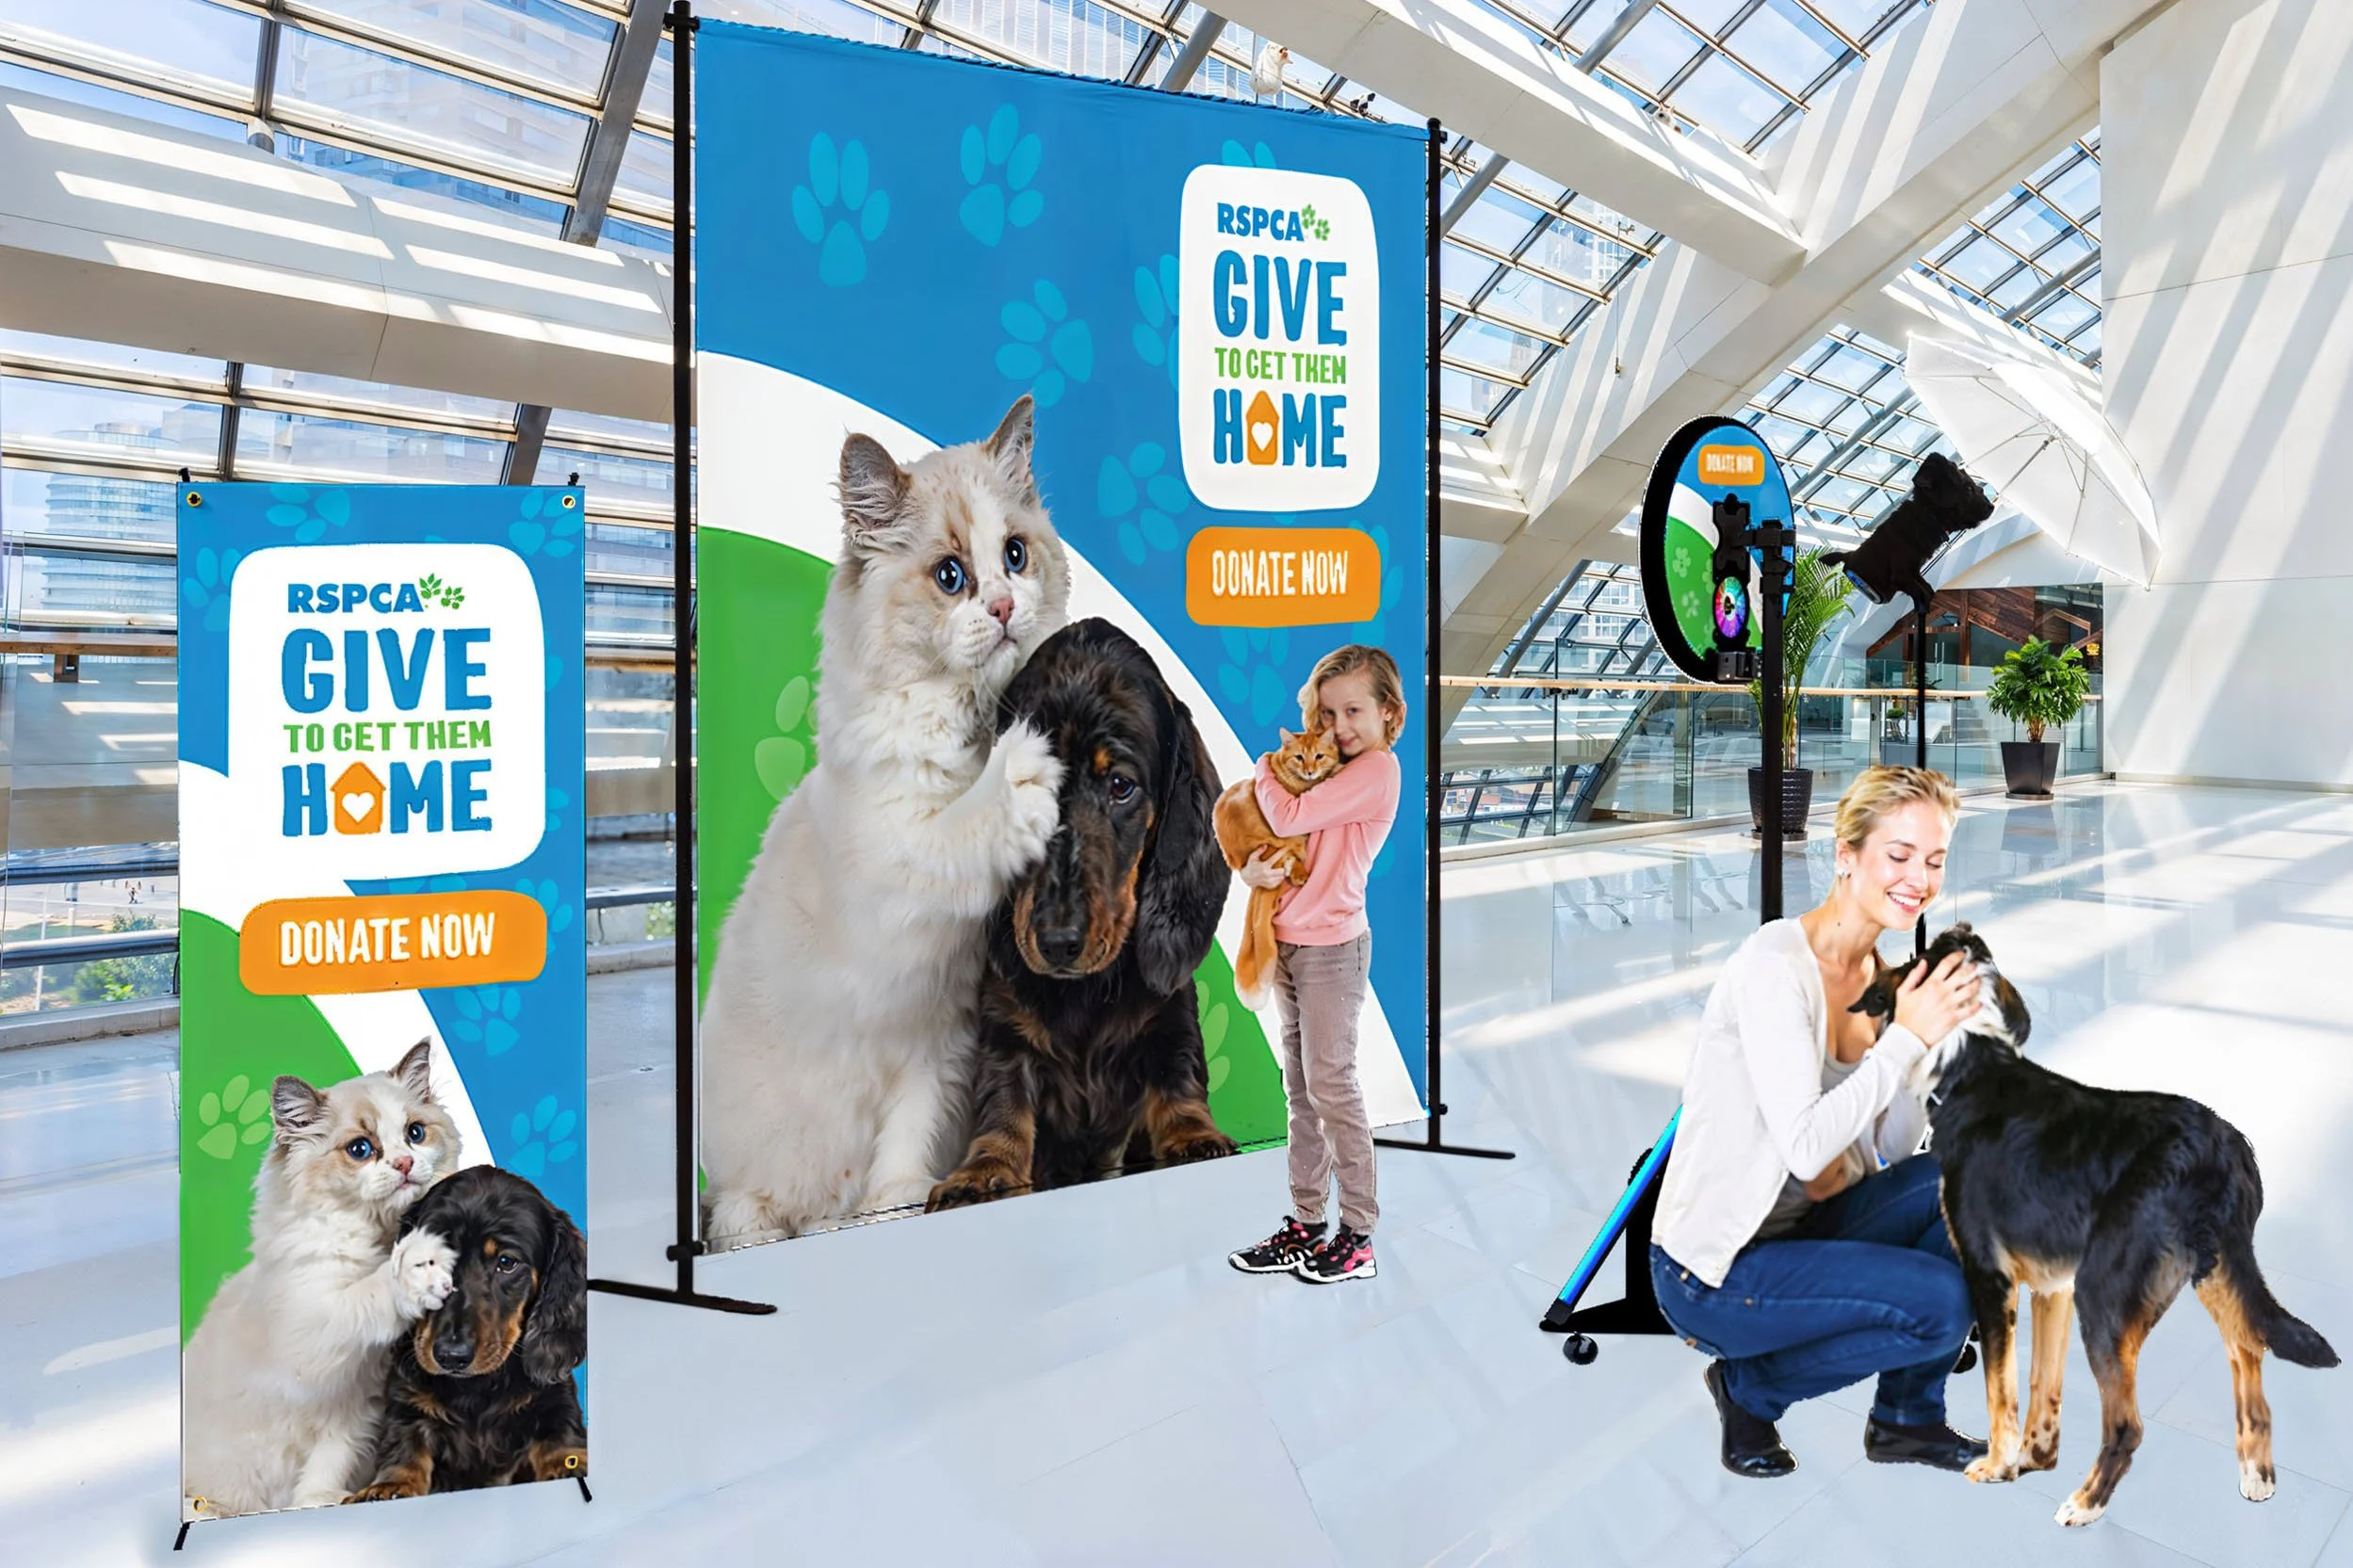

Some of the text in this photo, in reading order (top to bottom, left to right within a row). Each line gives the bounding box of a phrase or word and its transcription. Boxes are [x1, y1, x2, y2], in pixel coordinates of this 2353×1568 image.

[1217, 202, 1305, 242] RSPCA
[1213, 250, 1347, 346] GIVE
[1214, 347, 1346, 384] TO GET THEM
[1212, 549, 1348, 596] DONATE NOW
[287, 583, 425, 614] RSPCA
[283, 627, 492, 713] GIVE
[283, 719, 492, 753] TO GET THEM
[280, 912, 495, 966] DONATE NOW
